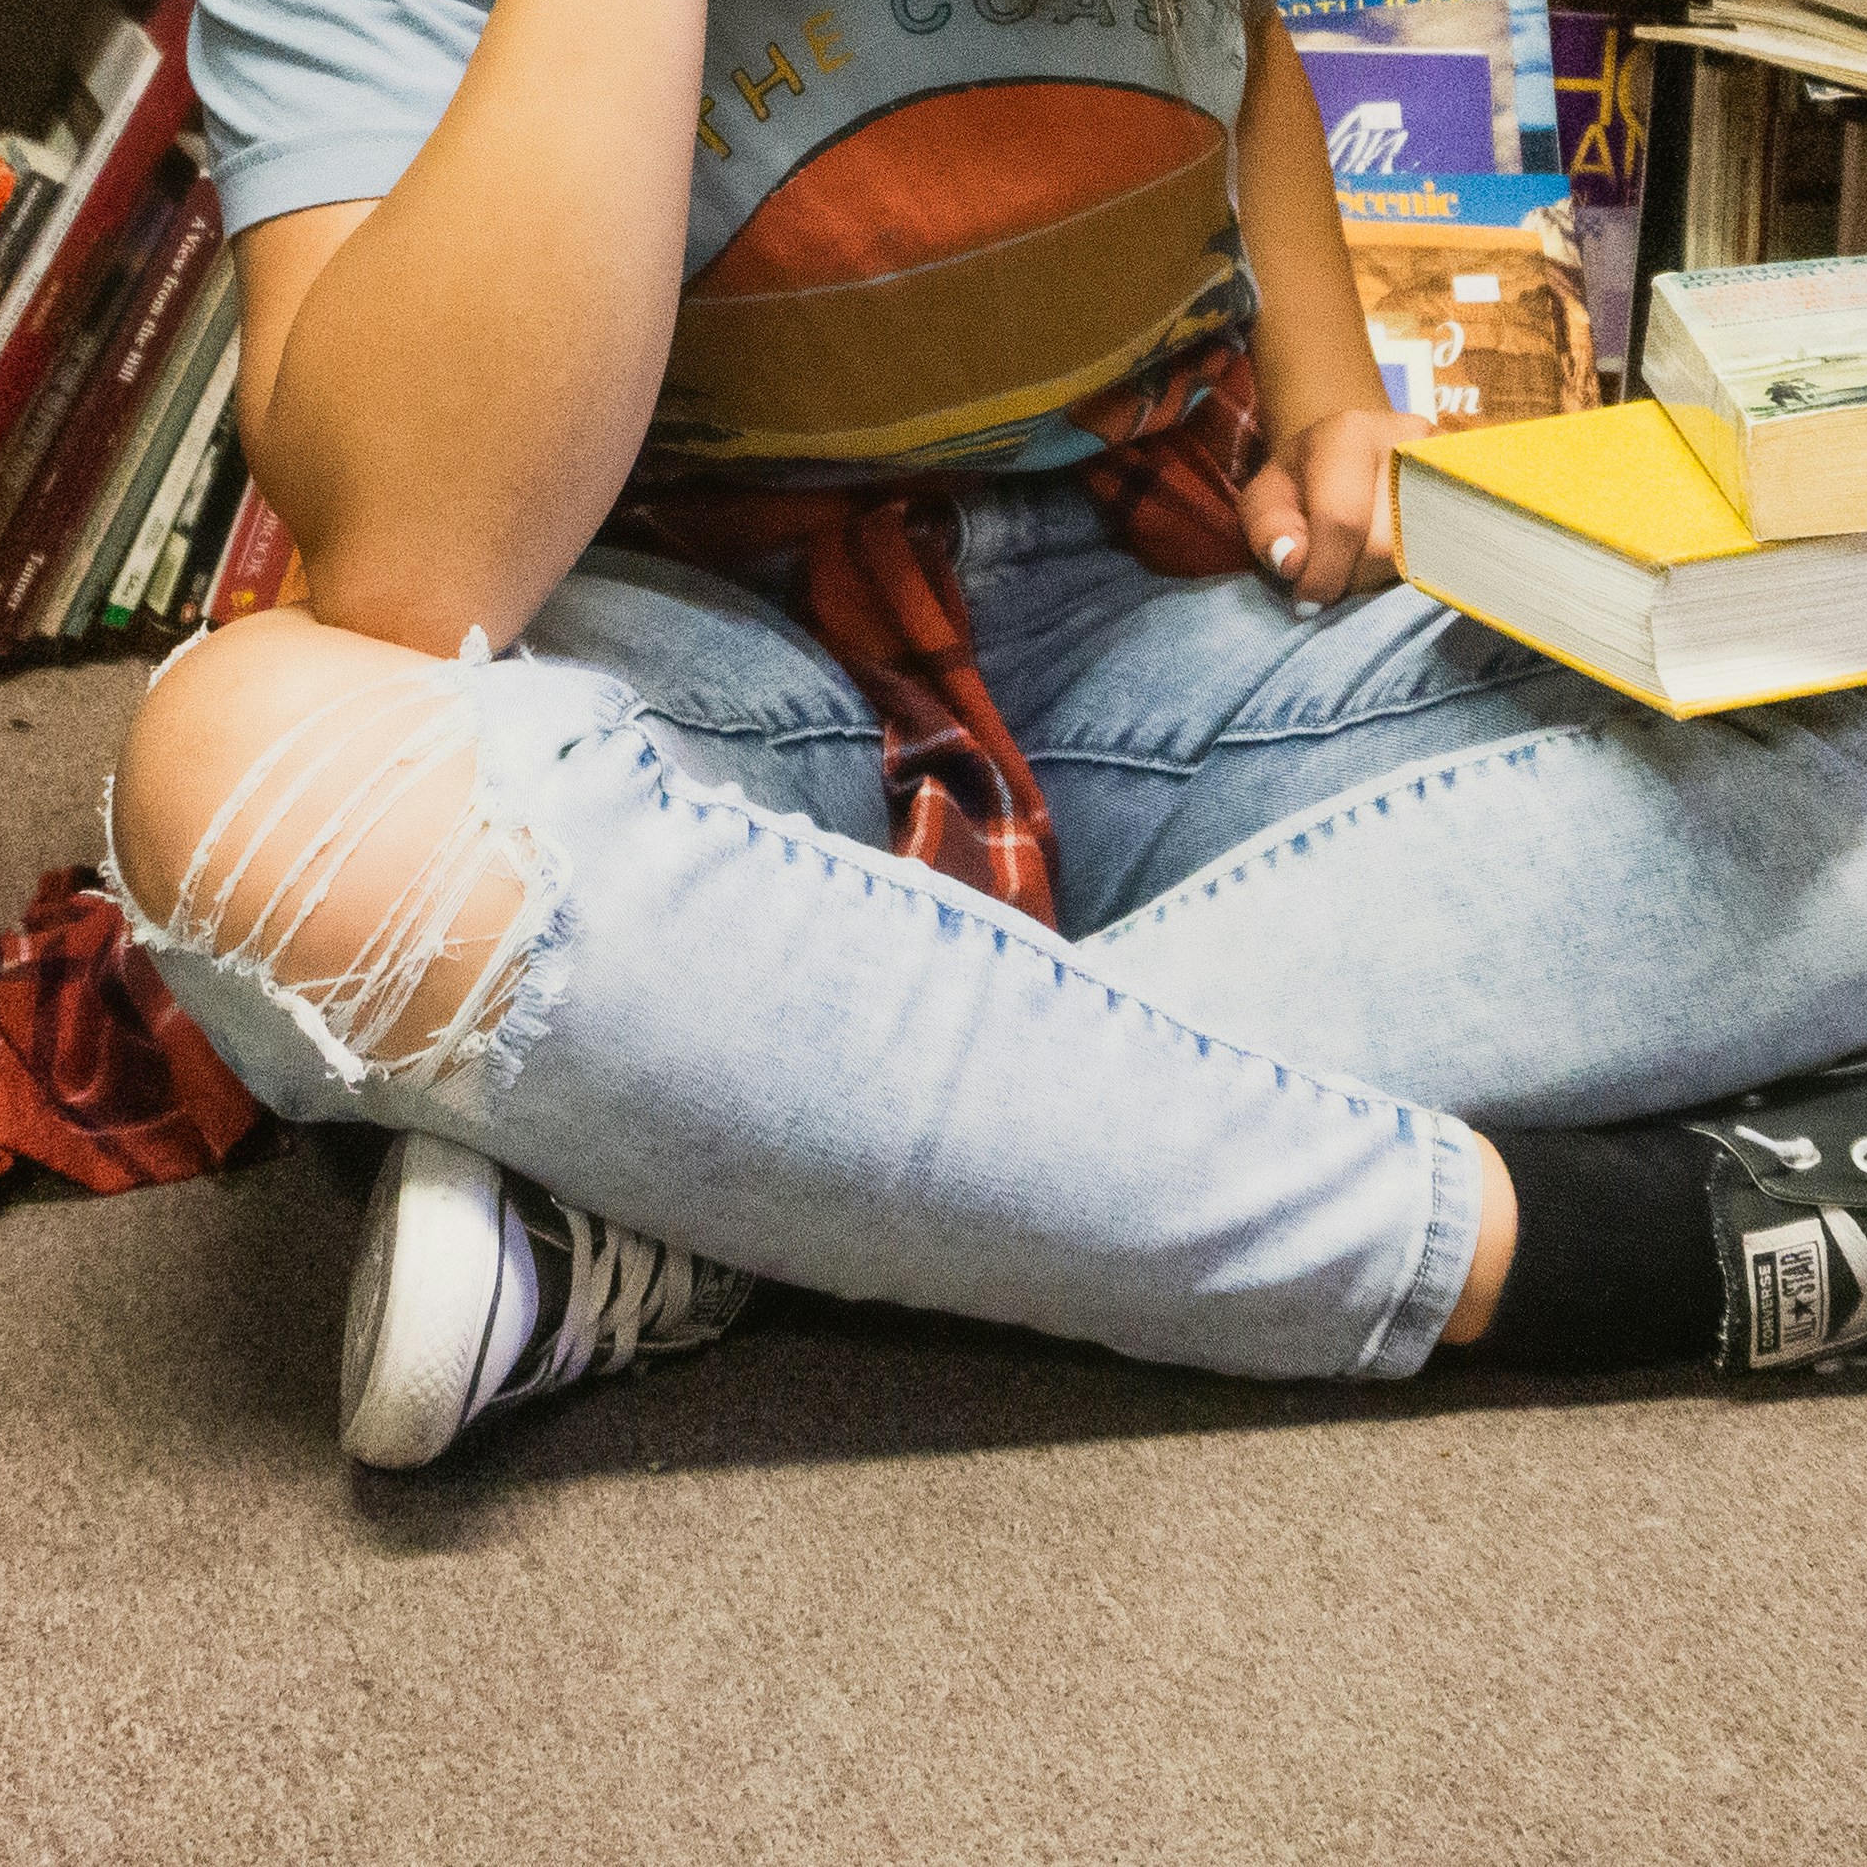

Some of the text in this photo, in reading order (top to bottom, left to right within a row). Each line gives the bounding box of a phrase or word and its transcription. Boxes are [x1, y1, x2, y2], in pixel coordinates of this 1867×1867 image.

[696, 9, 857, 161] THE
[169, 229, 200, 274] View
[147, 272, 180, 319] from
[132, 316, 159, 350] the
[115, 347, 145, 385] Hill
[1, 547, 48, 613] Tanner
[1780, 1248, 1817, 1297] STAR
[1757, 1264, 1775, 1348] CONVERSE
